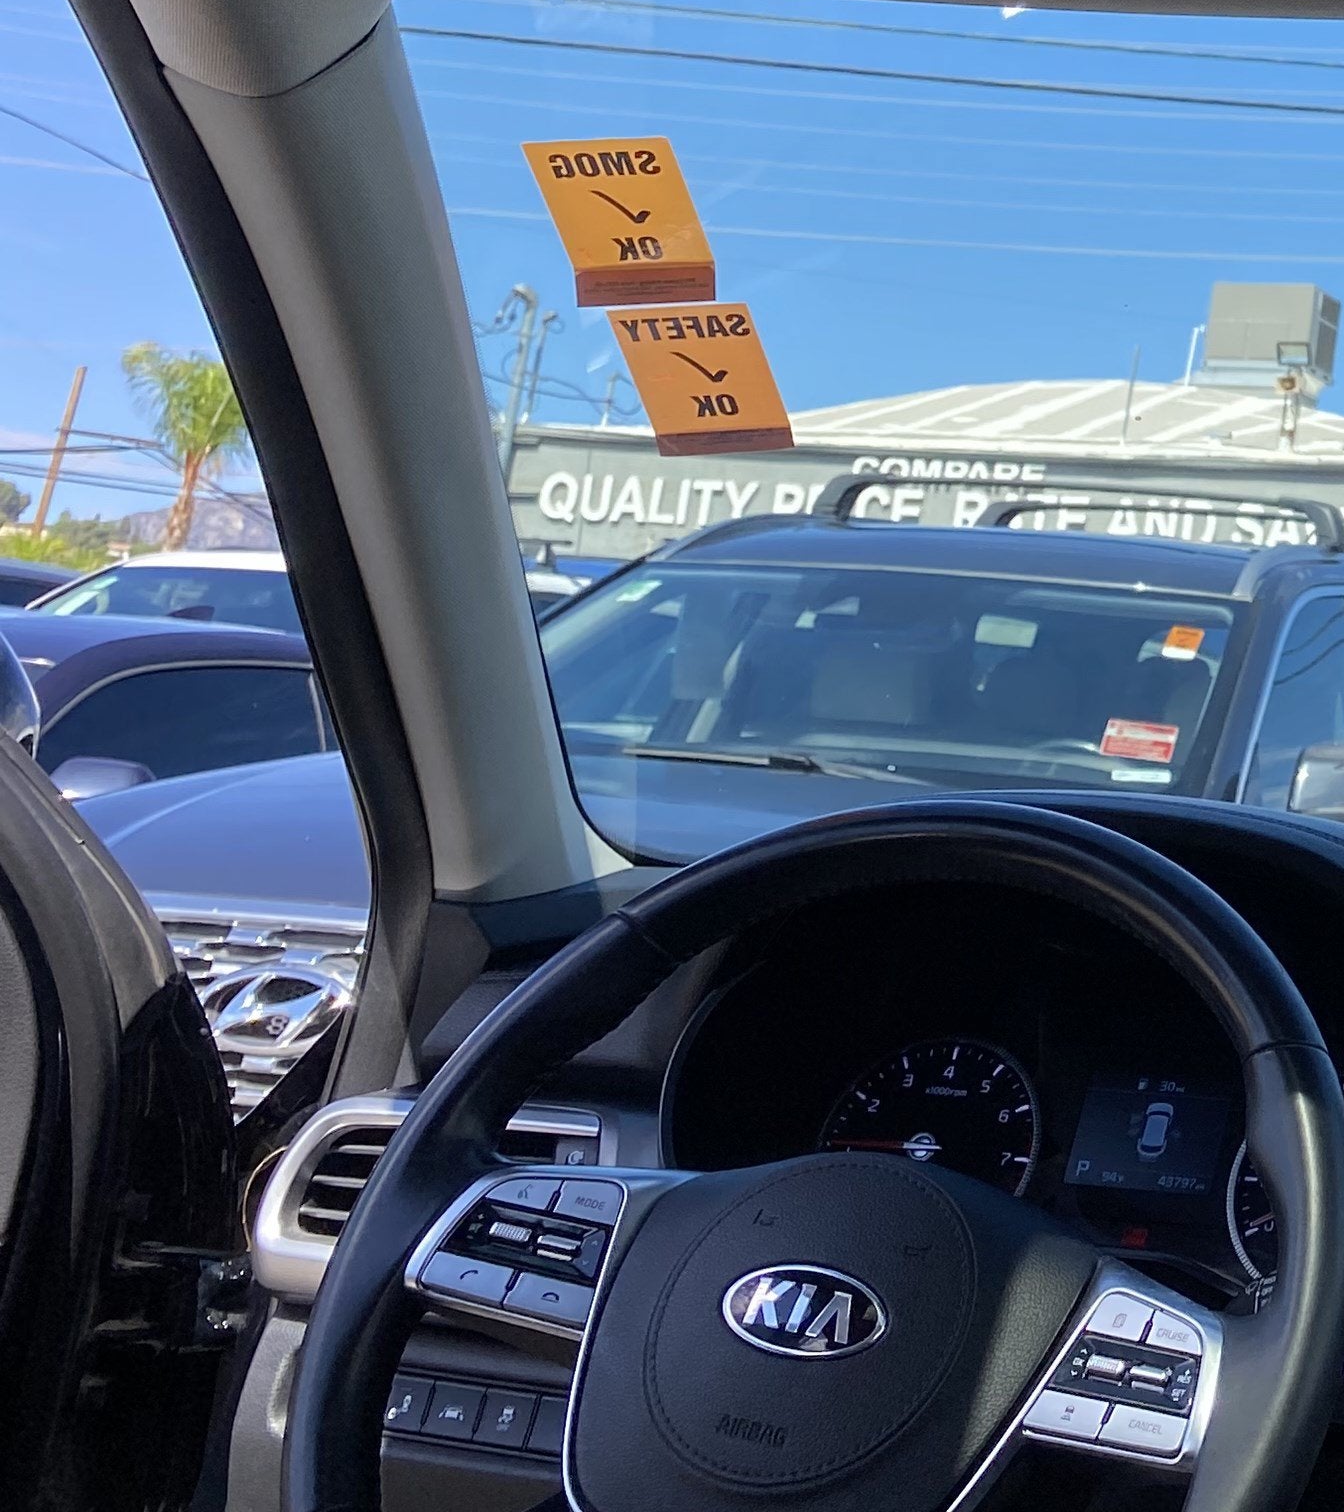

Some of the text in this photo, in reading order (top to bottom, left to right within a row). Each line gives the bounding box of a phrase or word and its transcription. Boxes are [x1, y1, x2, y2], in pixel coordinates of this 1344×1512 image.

[538, 471, 760, 525] QUALITY
[943, 1065, 956, 1080] 4
[902, 1074, 914, 1088] 3
[979, 1079, 992, 1093] 5
[867, 1099, 881, 1113] 2
[998, 1109, 1010, 1124] 6
[1001, 1152, 1012, 1166] 7
[1075, 1160, 1091, 1177] P
[574, 1196, 607, 1211] MODE
[742, 1277, 852, 1345] KIA
[1156, 1328, 1190, 1343] CRUISE
[715, 1414, 786, 1449] AIRBAG
[1128, 1418, 1163, 1435] CANCEL
